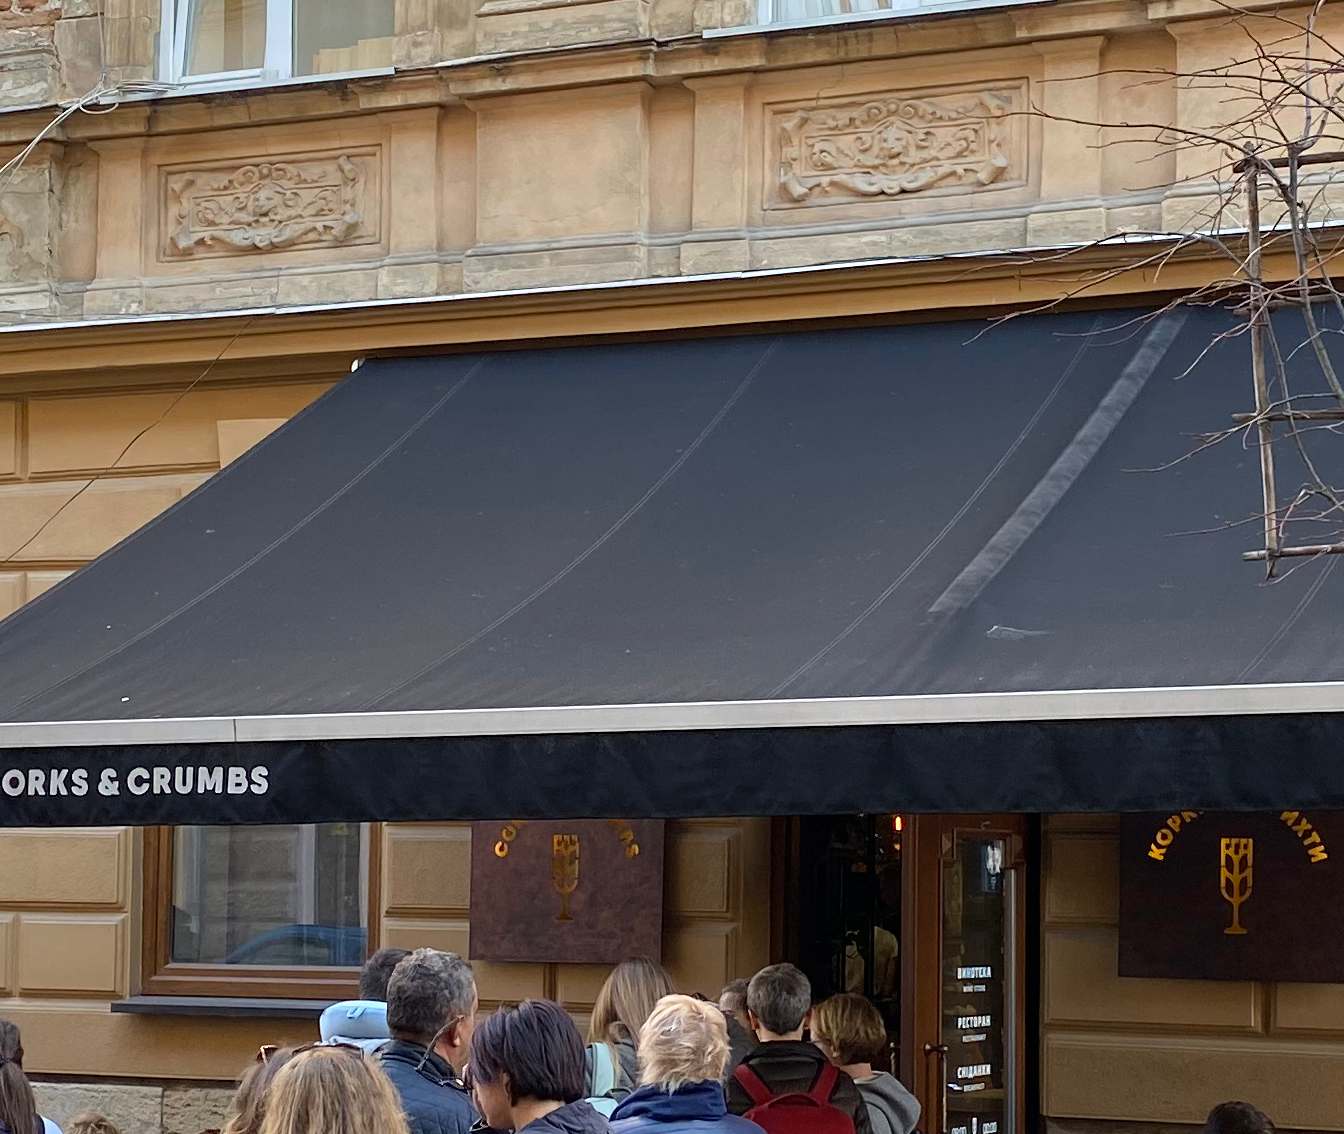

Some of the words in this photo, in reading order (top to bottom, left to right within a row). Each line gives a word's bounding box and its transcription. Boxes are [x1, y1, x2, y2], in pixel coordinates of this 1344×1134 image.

[97, 767, 120, 796] &
[126, 765, 269, 796] CRUMBS
[957, 1014, 991, 1029] РЕСТОРАН
